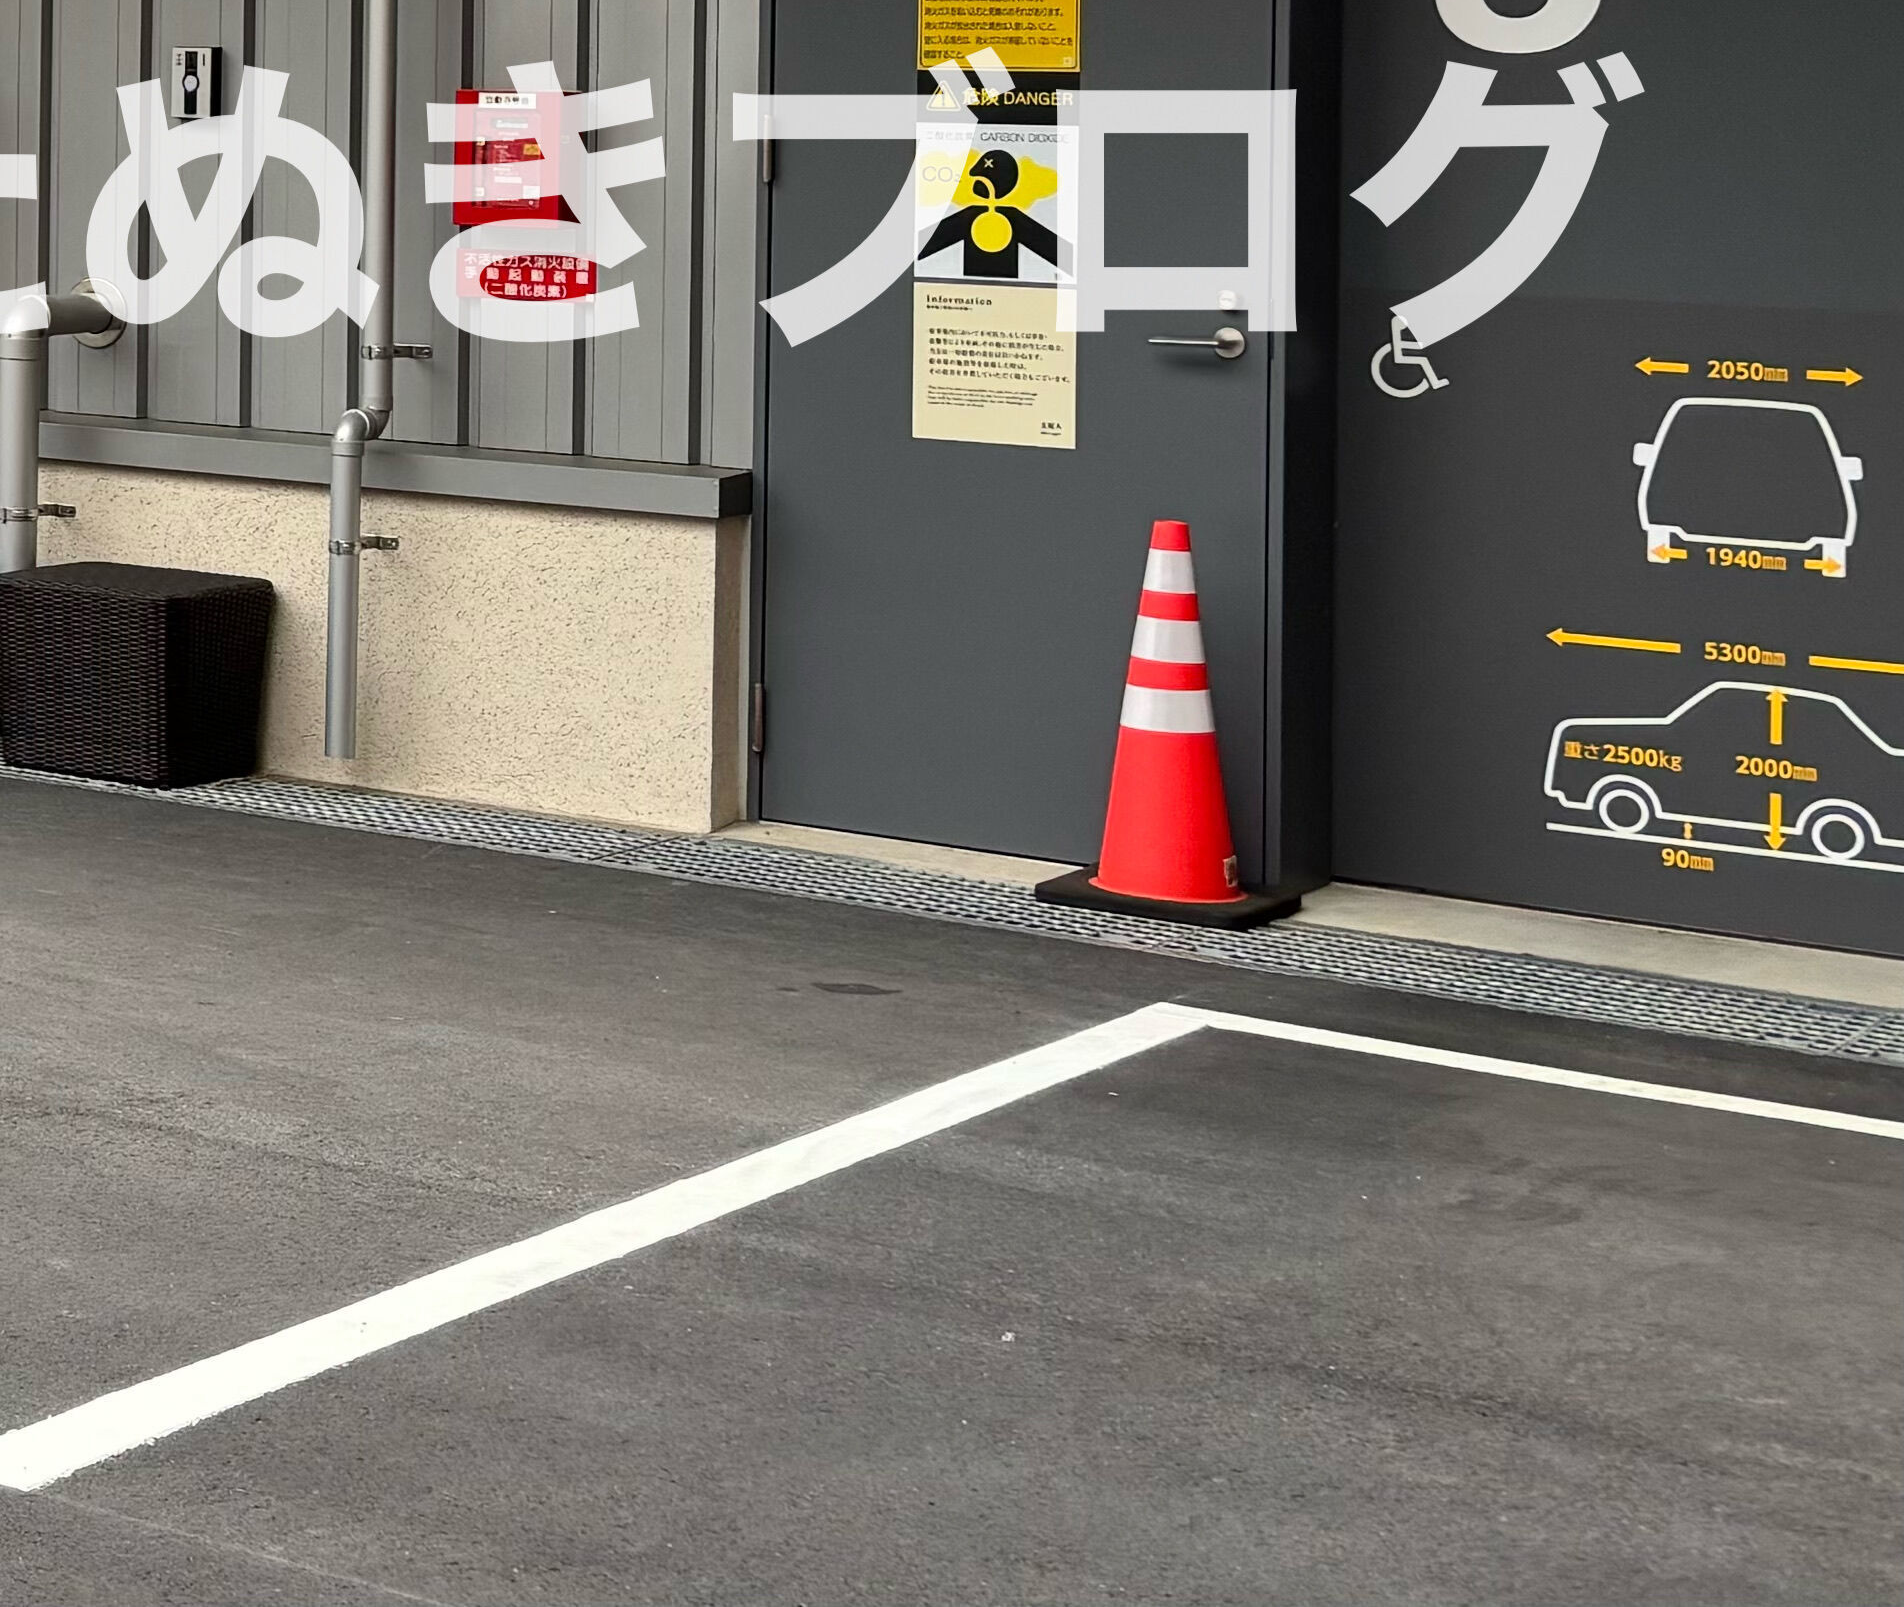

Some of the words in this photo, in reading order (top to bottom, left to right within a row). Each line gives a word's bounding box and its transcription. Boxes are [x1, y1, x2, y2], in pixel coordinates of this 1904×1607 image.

[963, 87, 1000, 106] 危険
[1004, 91, 1073, 106] DANGER
[1707, 360, 1788, 382] 2050mm
[1706, 547, 1786, 570] 1940mm
[1704, 641, 1786, 666] 5300mm
[1735, 756, 1817, 781] 2000mm
[1661, 848, 1714, 871] 90mm
